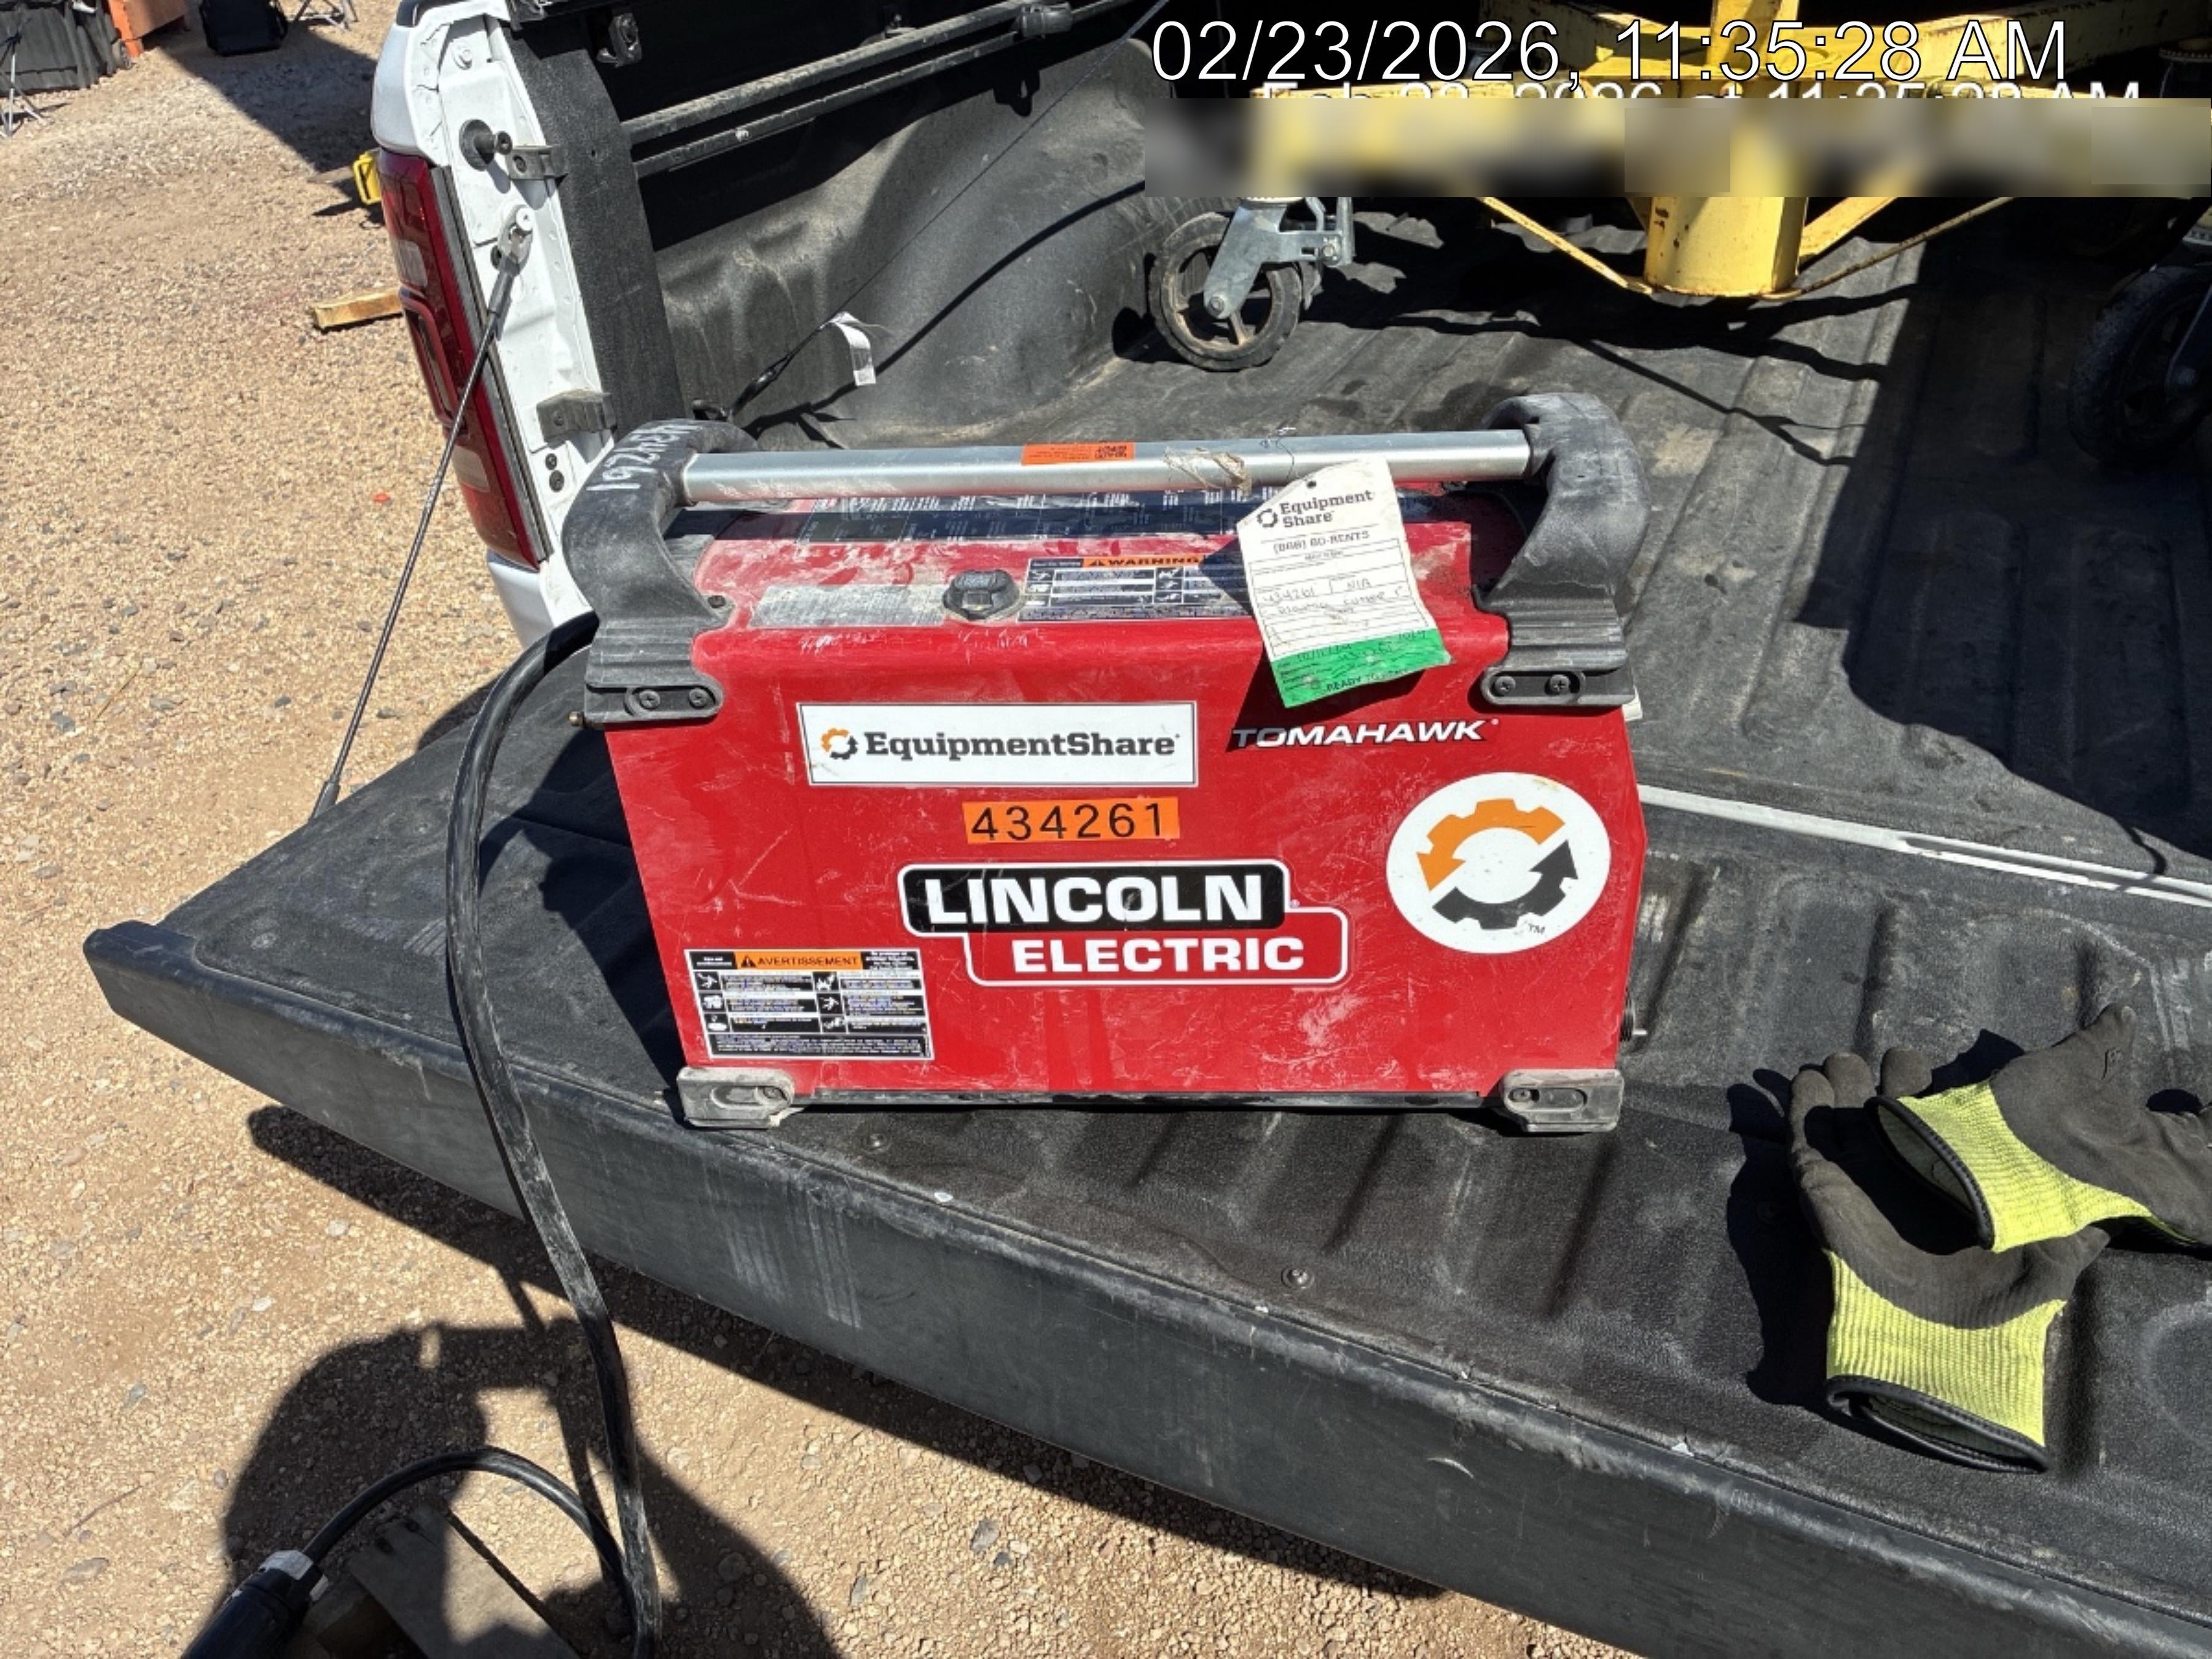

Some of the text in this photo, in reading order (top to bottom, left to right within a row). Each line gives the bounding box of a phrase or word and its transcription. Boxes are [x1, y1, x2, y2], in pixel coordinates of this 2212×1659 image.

[1279, 490, 1374, 514] Equipment
[1282, 511, 1333, 528] Share
[864, 731, 1175, 761] EquipmentShare
[1233, 720, 1486, 748] TOMAHAWK
[971, 803, 1161, 840] 434261
[925, 874, 1262, 924] LINCOLN
[758, 956, 858, 967] AVERTISSEMENT
[1011, 937, 1304, 973] ELECTRIC
